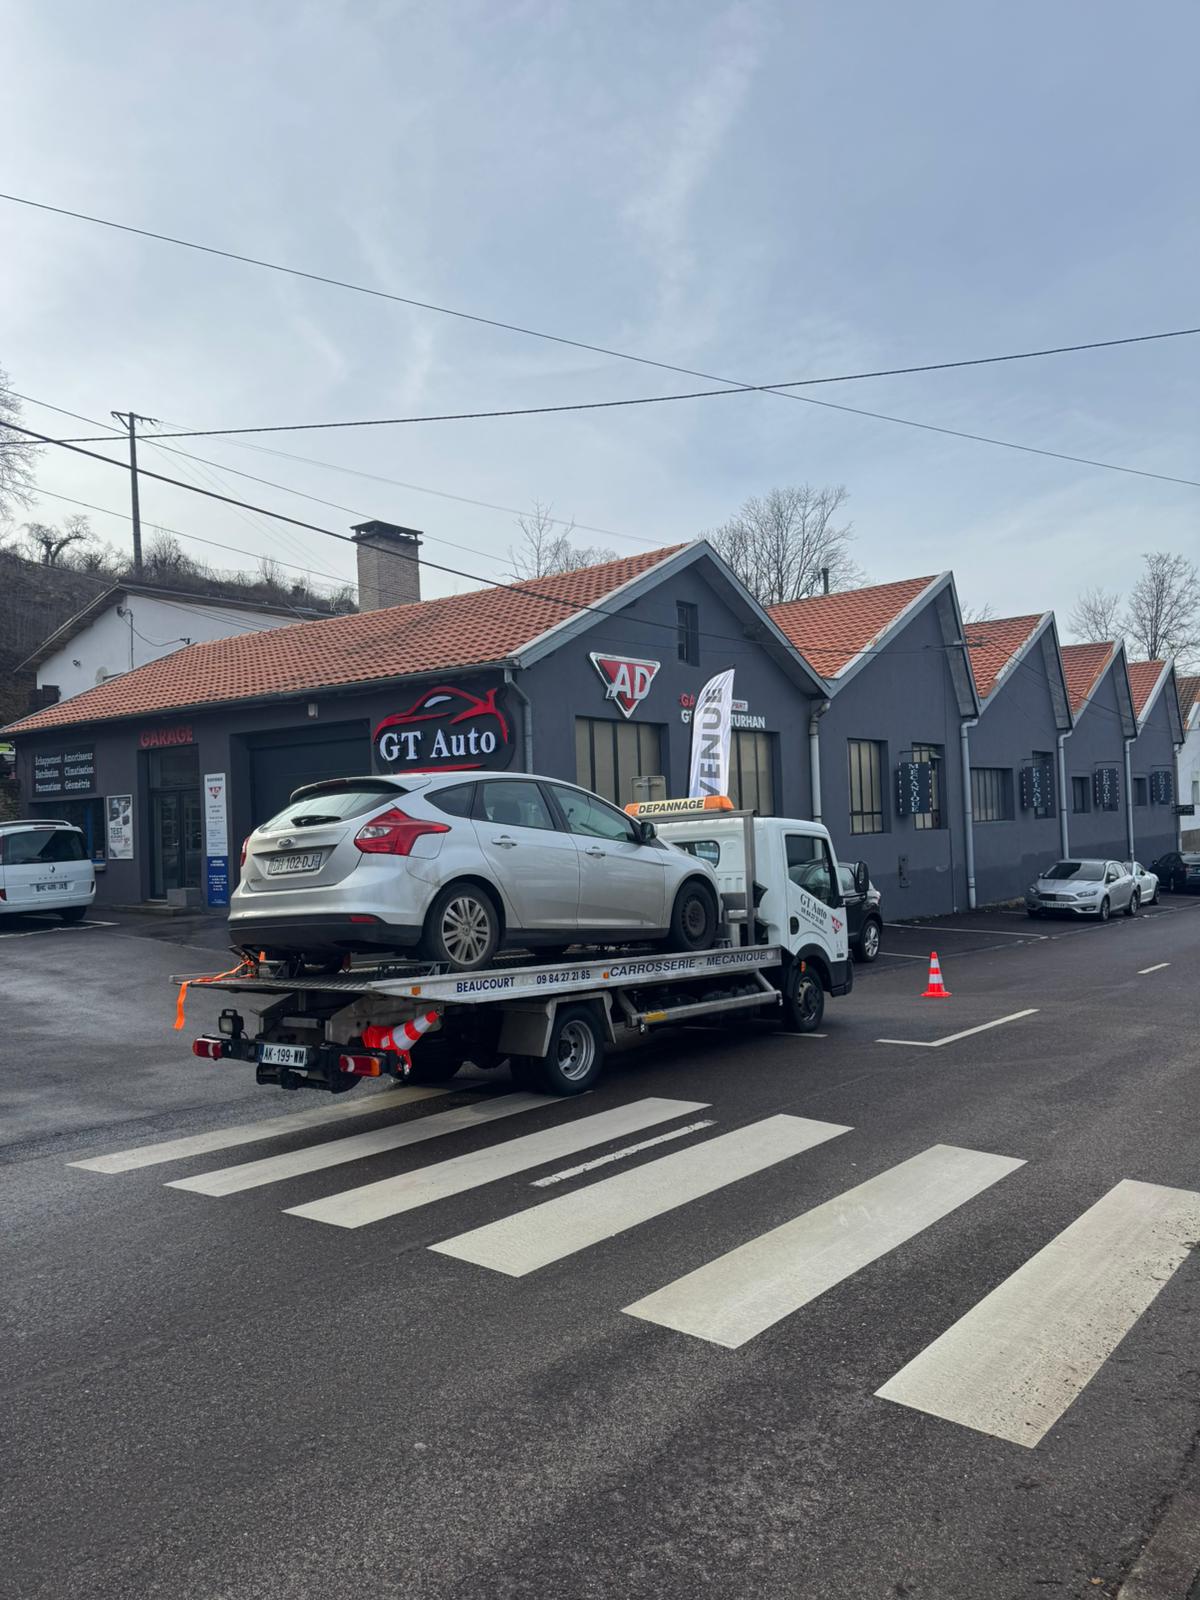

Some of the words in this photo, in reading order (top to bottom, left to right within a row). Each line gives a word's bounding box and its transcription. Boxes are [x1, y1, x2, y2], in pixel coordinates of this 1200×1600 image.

[606, 663, 651, 700] AD
[140, 727, 193, 748] GARAGE
[380, 730, 421, 761] GT
[430, 727, 496, 758] Auto
[638, 799, 704, 814] DEPANNAGE
[800, 893, 811, 908] GT
[811, 902, 828, 920] Auto
[536, 974, 547, 985] 09
[549, 973, 559, 983] 84
[560, 972, 570, 982] 27
[571, 971, 580, 981] 21
[581, 969, 591, 980] 85
[610, 958, 696, 977] CARROSSERIE
[456, 976, 516, 993] BEAUCOURT
[263, 1047, 305, 1064] AK-199-WM
